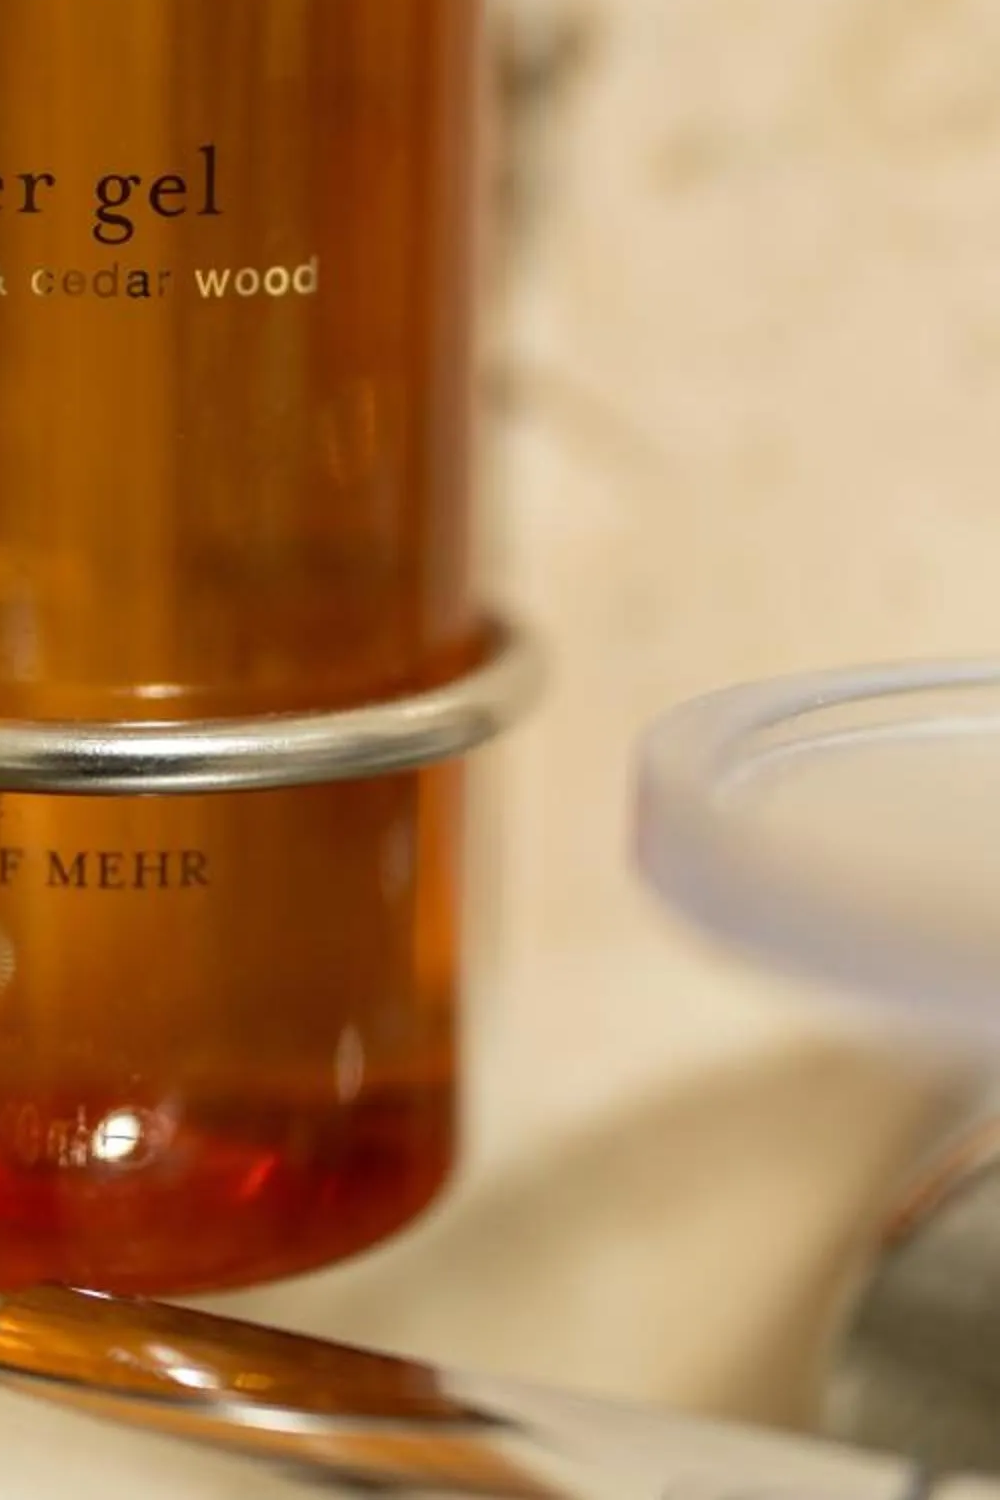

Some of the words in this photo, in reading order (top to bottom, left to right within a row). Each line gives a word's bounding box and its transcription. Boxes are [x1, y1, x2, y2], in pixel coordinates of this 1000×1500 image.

[92, 145, 224, 245] gel
[31, 263, 173, 300] cedar
[195, 255, 319, 299] wood
[45, 848, 212, 889] MEHR
